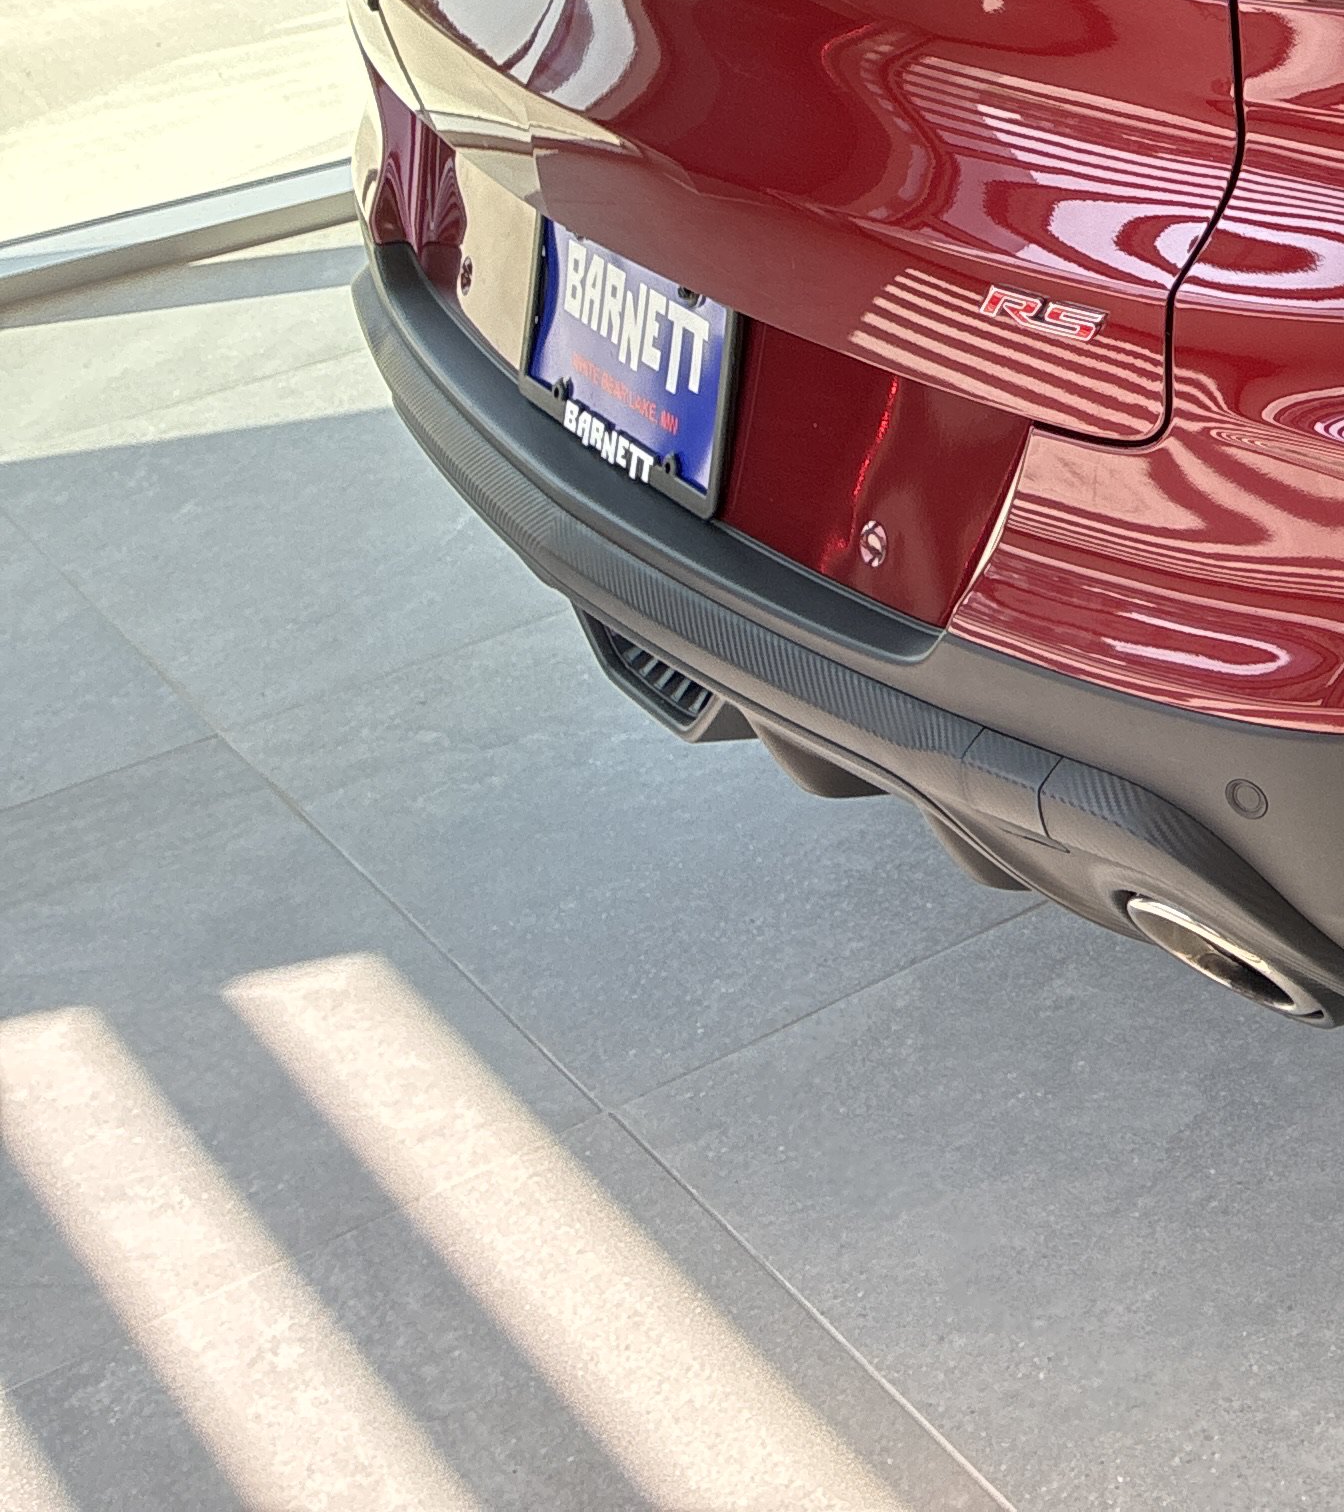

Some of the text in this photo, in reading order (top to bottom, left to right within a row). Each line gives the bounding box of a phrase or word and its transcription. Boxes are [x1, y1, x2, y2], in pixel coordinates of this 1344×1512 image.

[564, 239, 710, 395] BARNETT
[979, 284, 1107, 342] RS
[563, 399, 654, 484] BARNETT
